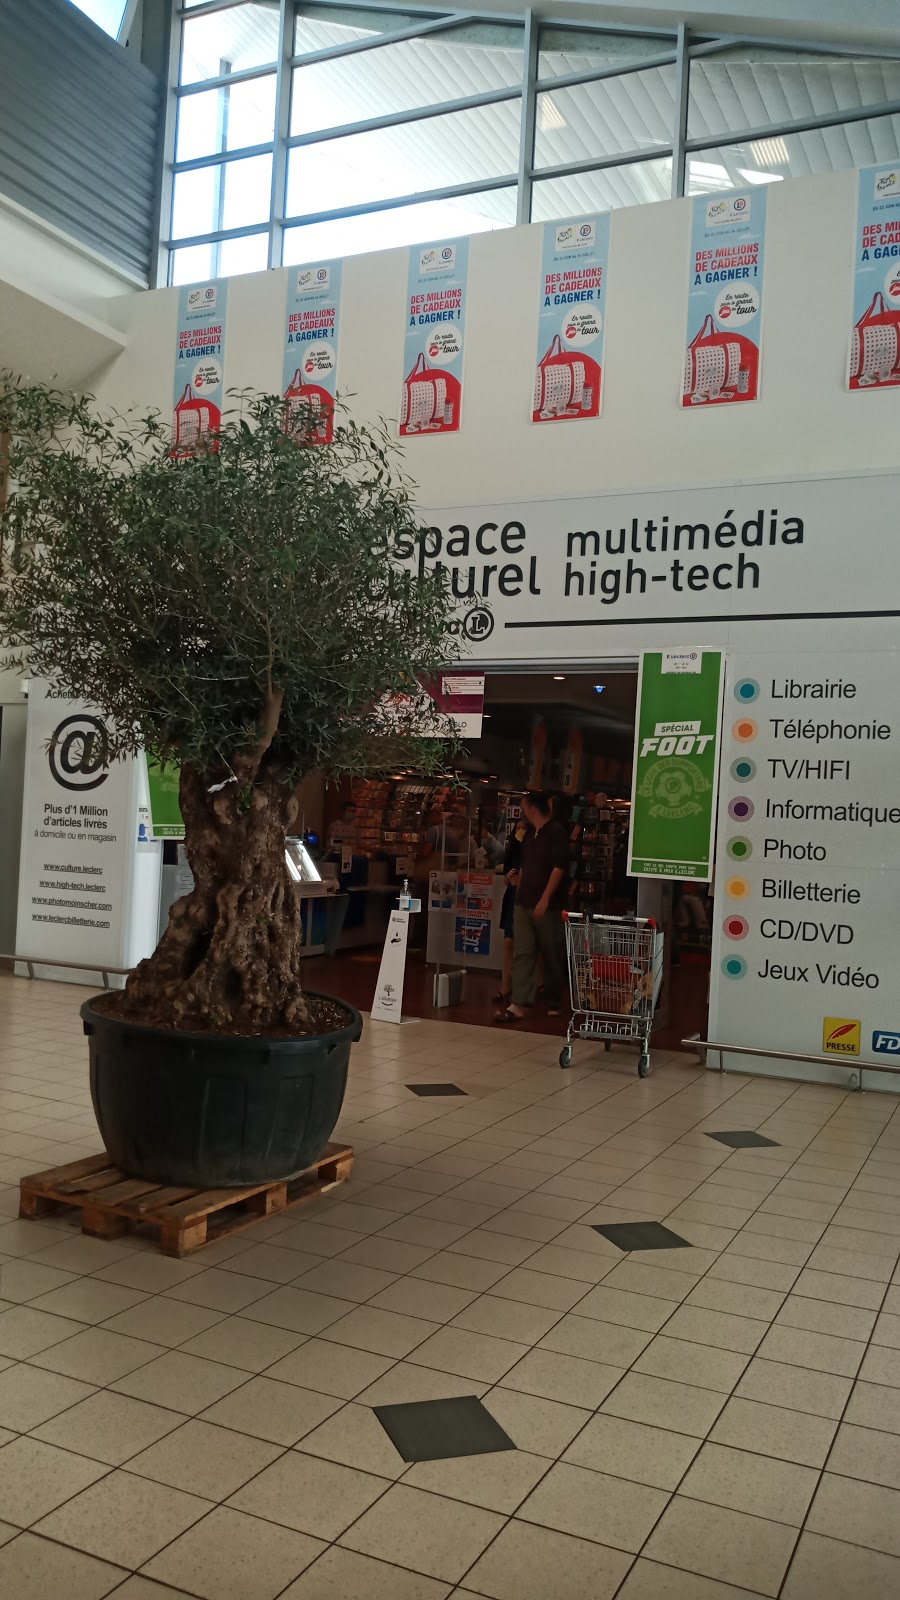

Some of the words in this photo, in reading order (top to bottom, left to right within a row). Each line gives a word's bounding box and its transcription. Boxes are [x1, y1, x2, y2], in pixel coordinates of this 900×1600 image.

[863, 224, 882, 236] DES
[862, 236, 877, 248] DE
[696, 250, 712, 261] DES
[716, 243, 759, 257] MILLIONS
[696, 262, 708, 272] DE
[711, 254, 758, 270] CADEAUX
[546, 274, 561, 283] DES
[564, 267, 602, 280] MILLIONS
[706, 268, 749, 283] GAGNER
[545, 284, 556, 295] DE
[559, 278, 601, 292] CADEAUX
[411, 295, 424, 304] DES
[427, 289, 462, 301] MILLIONS
[554, 291, 593, 305] GAGNER
[411, 305, 420, 314] DE
[423, 299, 461, 312] CADEAUX
[736, 306, 757, 314] tour
[289, 313, 301, 322] DES
[304, 308, 335, 320] MILLIONS
[419, 311, 454, 324] GAGNER
[180, 331, 191, 339] DES
[193, 326, 222, 337] MILLIONS
[289, 322, 297, 332] DE
[300, 318, 334, 330] CADEAUX
[581, 326, 599, 334] tour
[180, 340, 188, 349] DE
[190, 336, 221, 347] CADEAUX
[296, 329, 328, 342] GAGNER
[186, 346, 215, 358] GAGNER
[567, 509, 804, 557] multimédia
[565, 553, 760, 605] high-tech
[772, 679, 856, 698] Librairie
[661, 724, 694, 732] SPÉCIAL
[770, 719, 891, 743] Téléphonie
[640, 735, 714, 757] FOOT
[767, 759, 850, 780] TV/HIFI
[44, 804, 62, 814] Plus
[80, 806, 108, 816] Million
[766, 799, 900, 827] Informatique
[44, 817, 81, 827] d'articles
[84, 818, 107, 829] livrés
[40, 830, 66, 839] domicile
[88, 834, 116, 843] magasin
[764, 838, 827, 861] Photo
[44, 863, 103, 874] www.culture.leclerc
[40, 881, 105, 892] www.high-tech.leclerc
[762, 878, 861, 904] Billetterie
[32, 896, 112, 911] www.photomoinscher.com
[32, 913, 110, 928] www.leclercbilletterie.com
[760, 918, 854, 945] CD/DVD
[758, 959, 809, 982] Jeux
[816, 963, 879, 989] Vidéo
[826, 1042, 856, 1051] PRESSE
